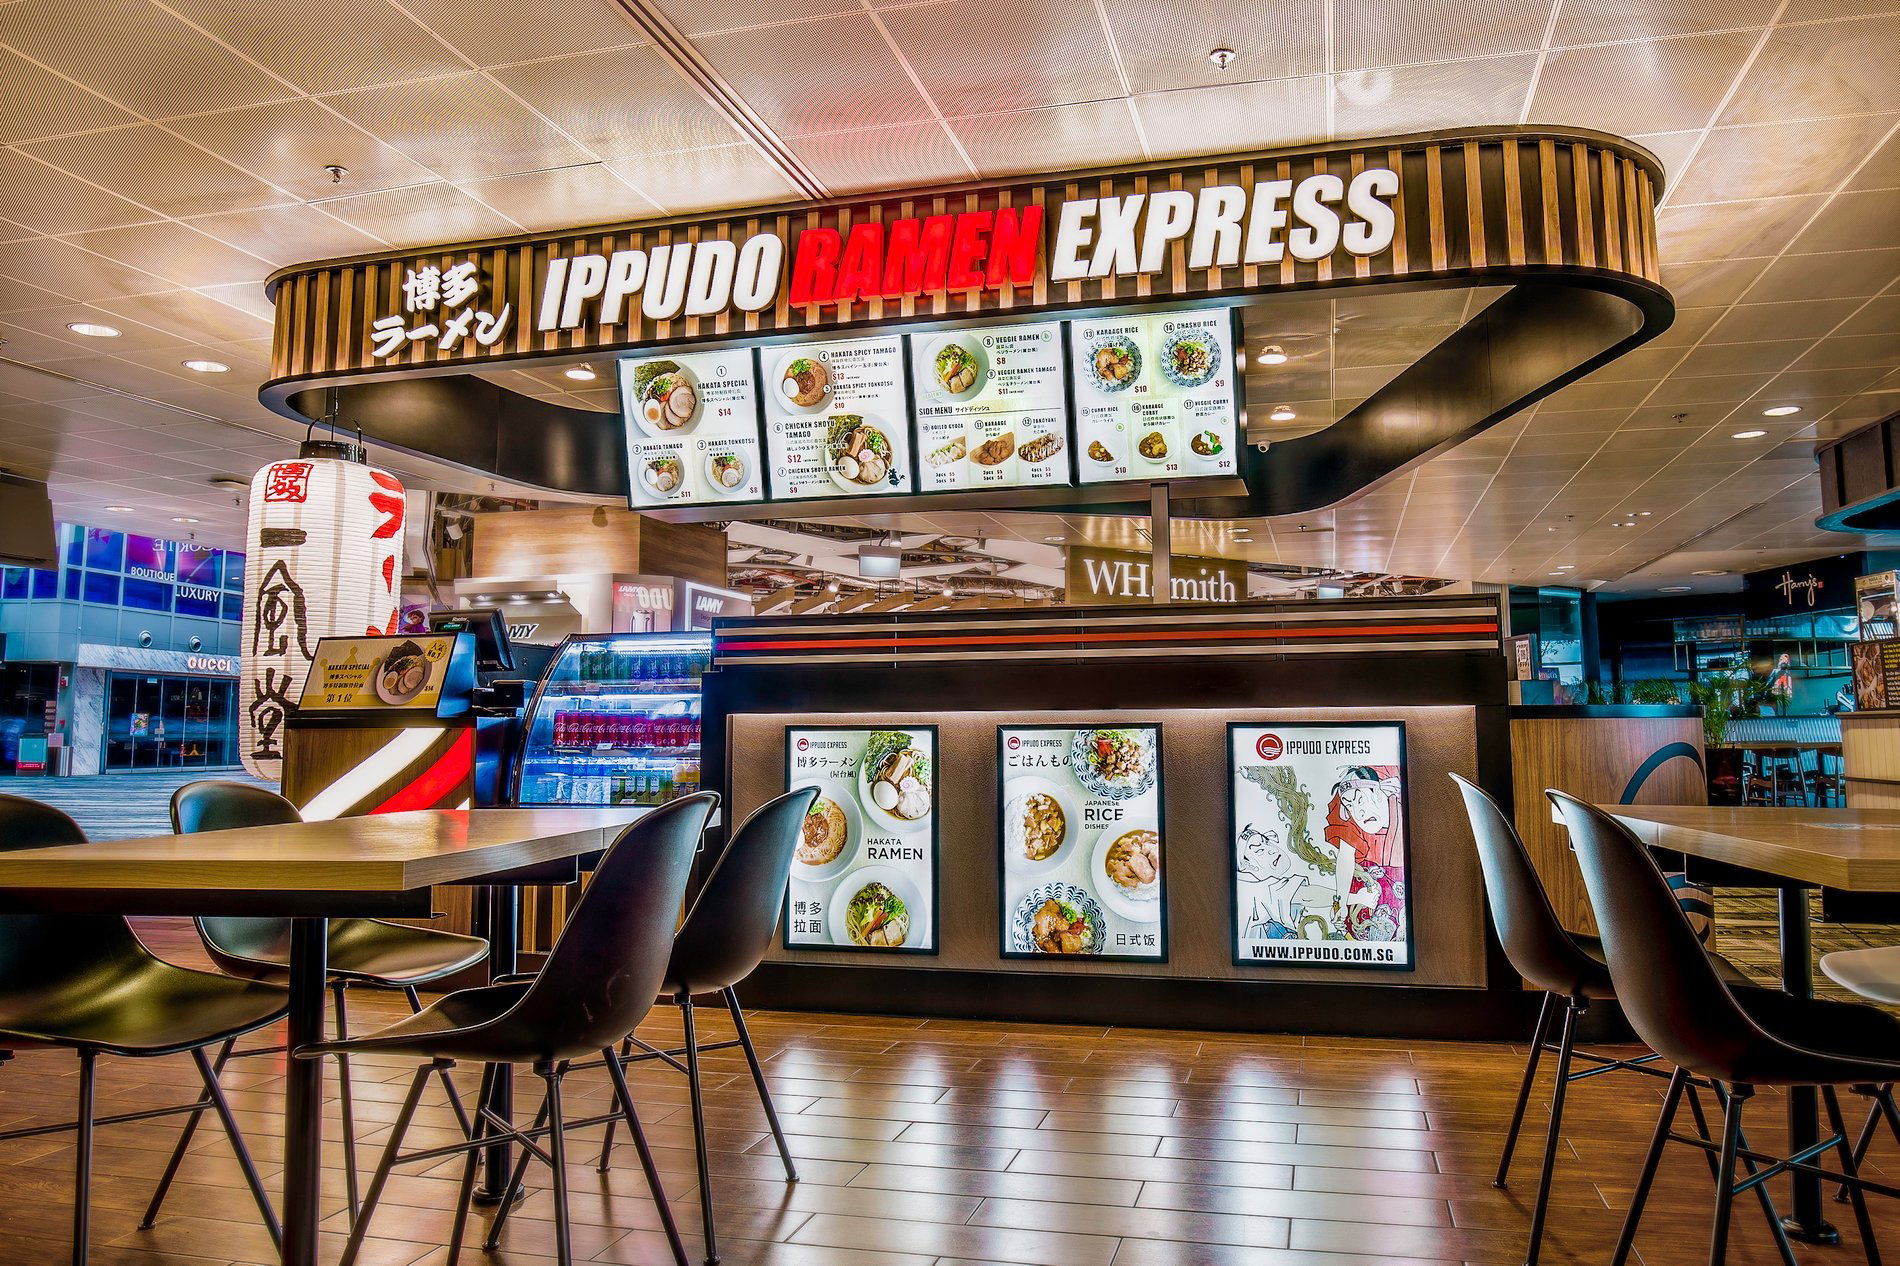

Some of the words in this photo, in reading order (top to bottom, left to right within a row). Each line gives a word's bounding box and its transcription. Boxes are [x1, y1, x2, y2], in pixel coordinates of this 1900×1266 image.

[537, 233, 784, 332] IPPUDO
[789, 204, 1045, 308] RAMEN
[1051, 168, 1401, 282] EXPRESS
[402, 261, 480, 313] 博多
[371, 301, 513, 359] ラーメン
[1176, 321, 1201, 329] CHASHU
[1096, 327, 1124, 336] KARAAGE
[1124, 326, 1139, 334] RICE
[995, 335, 1017, 344] VEGGIE
[830, 350, 853, 358] HAKATA
[854, 348, 871, 356] SPICY
[996, 357, 1006, 365] $8
[998, 368, 1016, 376] VEGGIE
[698, 381, 721, 390] HAKATA
[722, 379, 748, 388] SPECIAL
[1134, 385, 1147, 393] $10
[1215, 380, 1224, 388] $9
[718, 408, 732, 417] $14
[919, 407, 934, 416] SIDE
[934, 406, 953, 414] MENU
[785, 422, 813, 430] CHICKEN
[813, 420, 835, 428] SHOYU
[786, 431, 811, 439] TAMAGO
[728, 438, 755, 446] TONKOTSU
[787, 454, 802, 463] $12
[131, 566, 175, 581] BOUTIQUE
[1083, 558, 1237, 603] WHmith
[175, 586, 220, 602] LUXURY
[1775, 571, 1818, 607] Harry's
[696, 595, 724, 614] LAMY
[187, 656, 232, 672] GUCCI
[826, 741, 848, 749] EXPRESS
[1021, 739, 1039, 748] IPPUDO
[1040, 739, 1062, 748] EXPRESS
[1286, 740, 1322, 755] IPPUDO
[1325, 740, 1370, 755] EXPRESS
[797, 757, 858, 768] 博多ラーメン
[1008, 754, 1072, 768] ごはんもの
[1084, 808, 1124, 821] RICE
[867, 848, 923, 860] RAMEN
[794, 901, 822, 916] 博多
[794, 919, 822, 934] 拉面
[1115, 933, 1156, 946] 日式饭
[1252, 945, 1394, 962] WWW.IPPUDO.COM.SG
